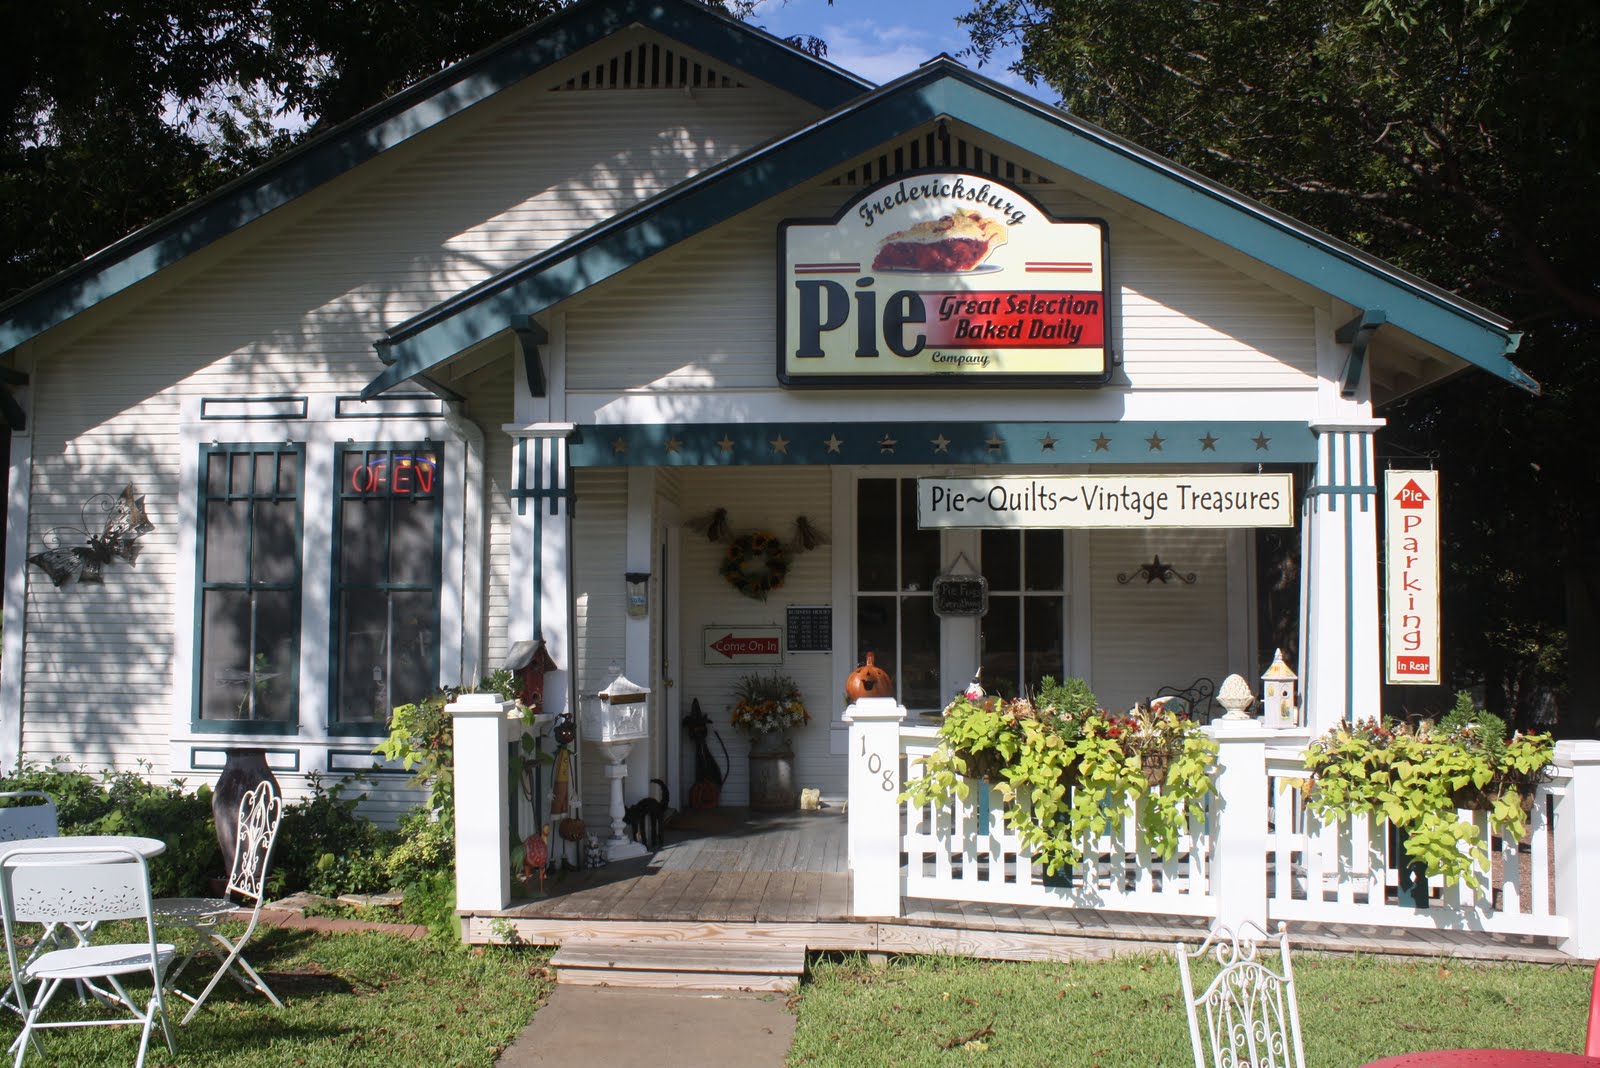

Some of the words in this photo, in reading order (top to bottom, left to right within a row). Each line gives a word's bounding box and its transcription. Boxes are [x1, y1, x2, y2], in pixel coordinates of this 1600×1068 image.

[859, 178, 1027, 227] Fredericksburg
[795, 276, 927, 358] Pie
[938, 296, 1000, 321] Great
[1004, 295, 1099, 315] Selection
[955, 319, 1024, 340] Baked
[1028, 320, 1083, 344] Daily
[931, 351, 991, 367] Company
[352, 464, 433, 493] OPEN
[1176, 484, 1281, 511] Treasures
[1402, 488, 1423, 502] Pie
[1402, 515, 1422, 651] Parking
[715, 640, 746, 652] Come
[748, 640, 764, 652] On
[767, 640, 777, 652] In
[1398, 662, 1407, 672] In
[1409, 661, 1430, 672] Rear
[861, 734, 895, 792] 108
